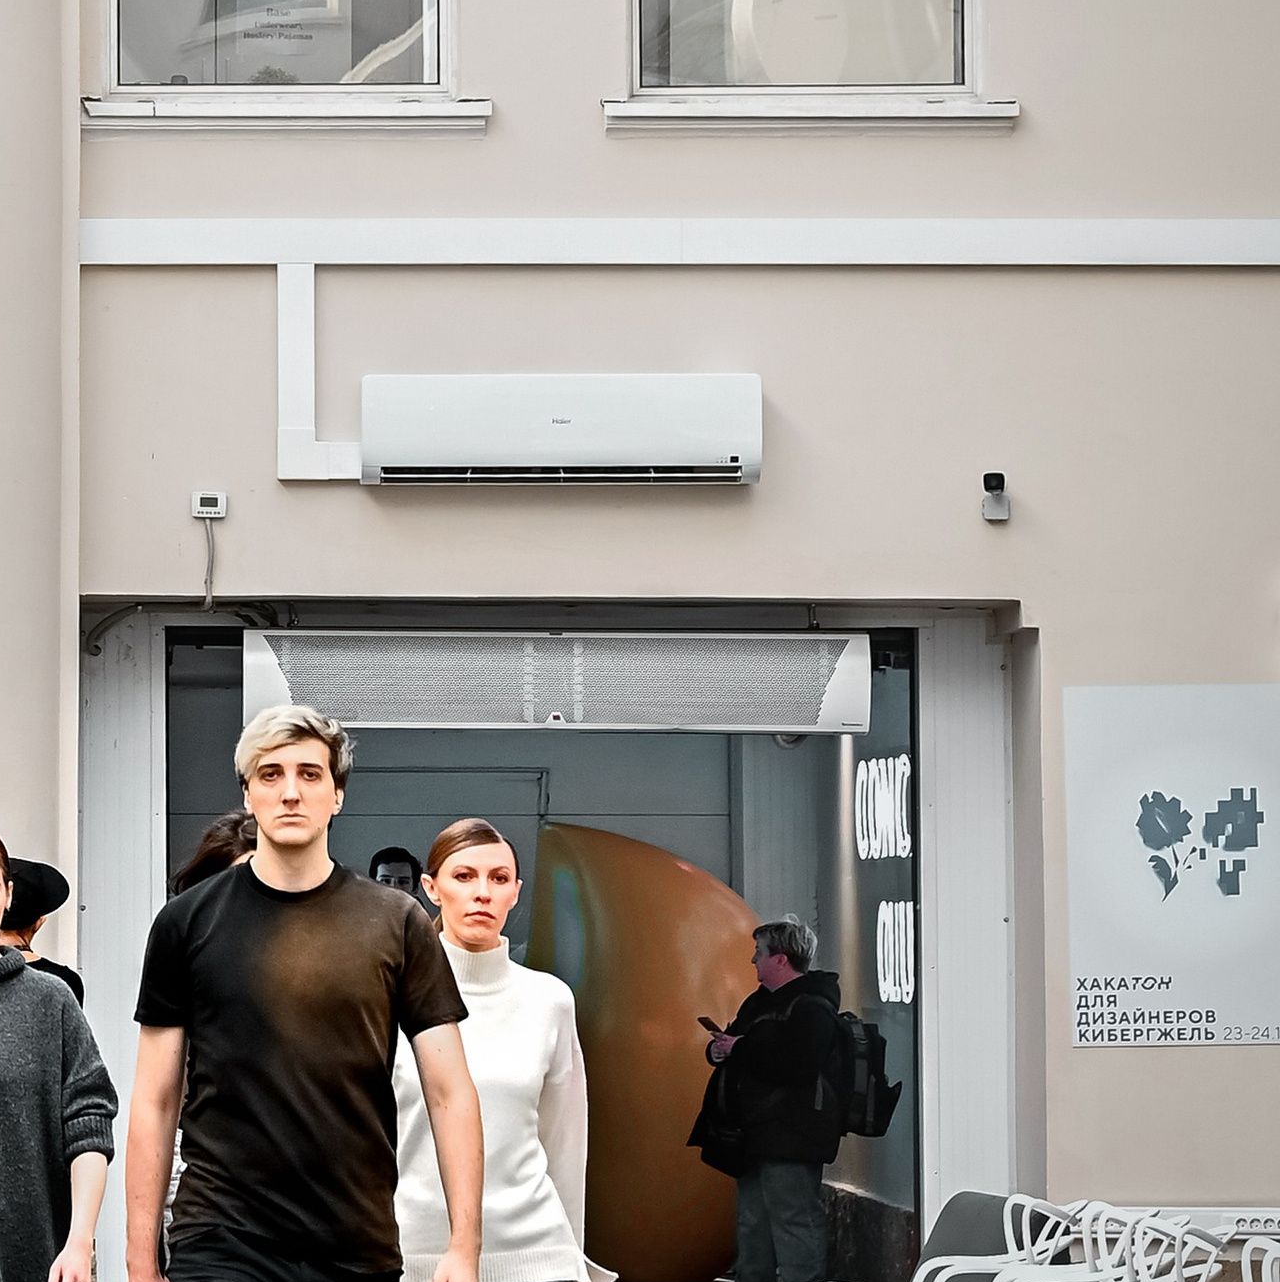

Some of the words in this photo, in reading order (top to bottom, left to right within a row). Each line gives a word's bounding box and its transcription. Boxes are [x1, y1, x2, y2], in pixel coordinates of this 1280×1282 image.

[1076, 976, 1172, 992] ХАКАТОН
[1076, 994, 1118, 1010] ДЛЯ
[1076, 1008, 1217, 1027] ДИЗАЙНЕРОВ
[1078, 1027, 1216, 1042] КИБЕРГЖЕЛЬ
